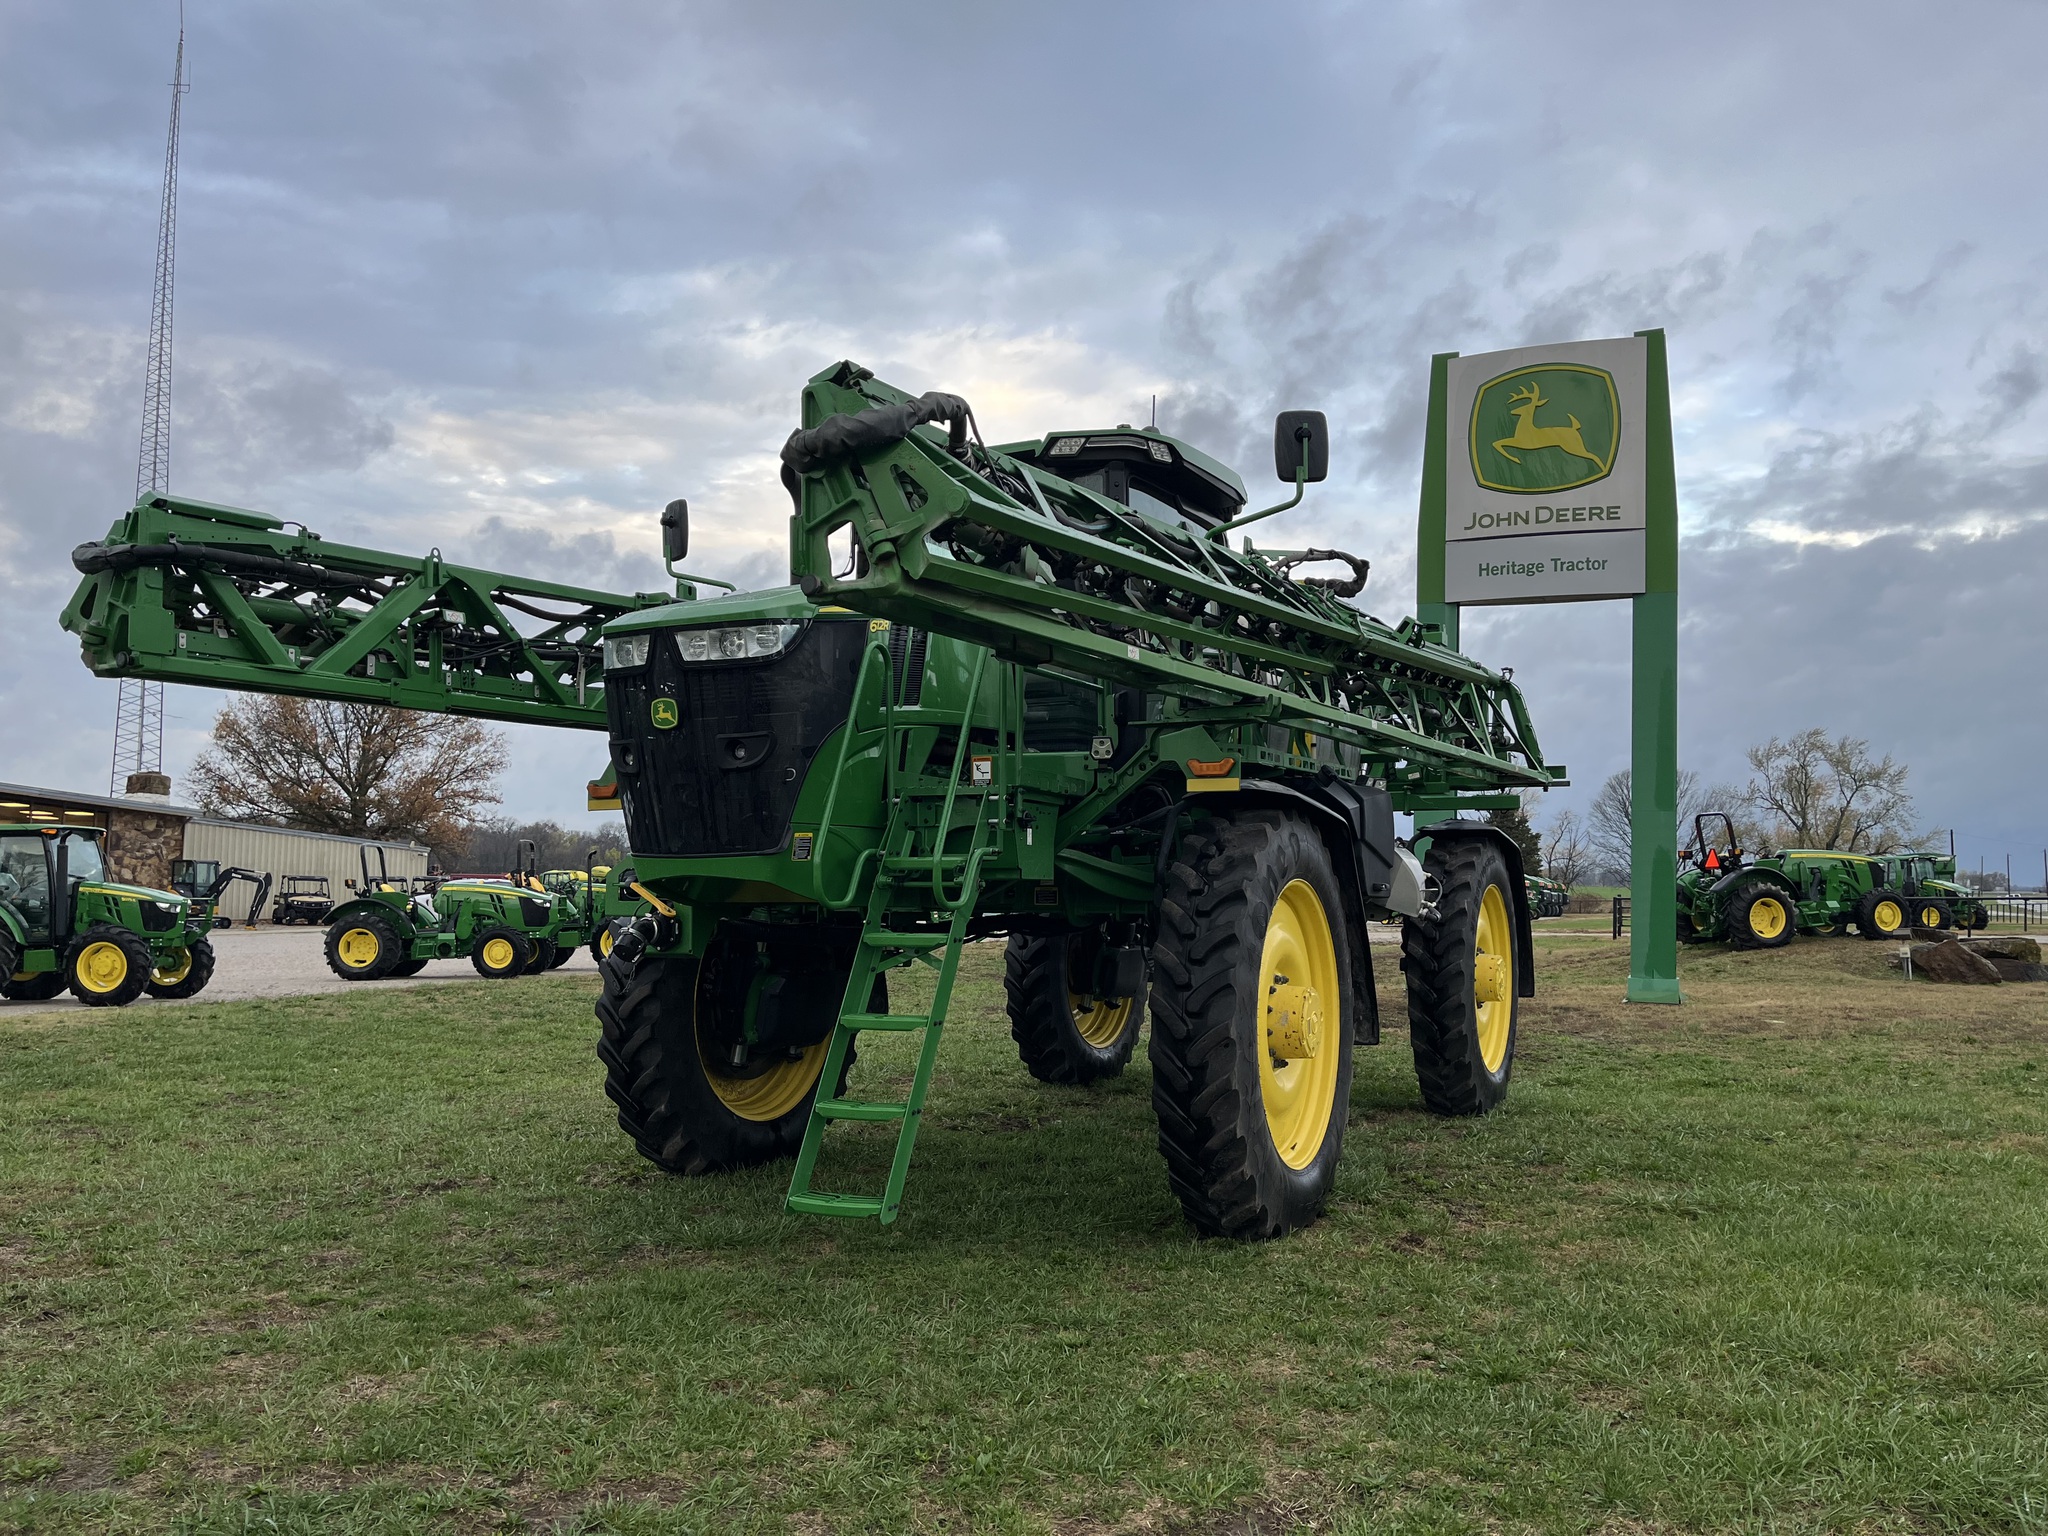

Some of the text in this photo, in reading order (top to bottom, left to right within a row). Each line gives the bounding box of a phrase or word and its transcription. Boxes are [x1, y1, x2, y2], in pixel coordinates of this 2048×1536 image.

[1464, 506, 1621, 531] JOHN DEERE
[1478, 557, 1608, 577] Heritage Tractor
